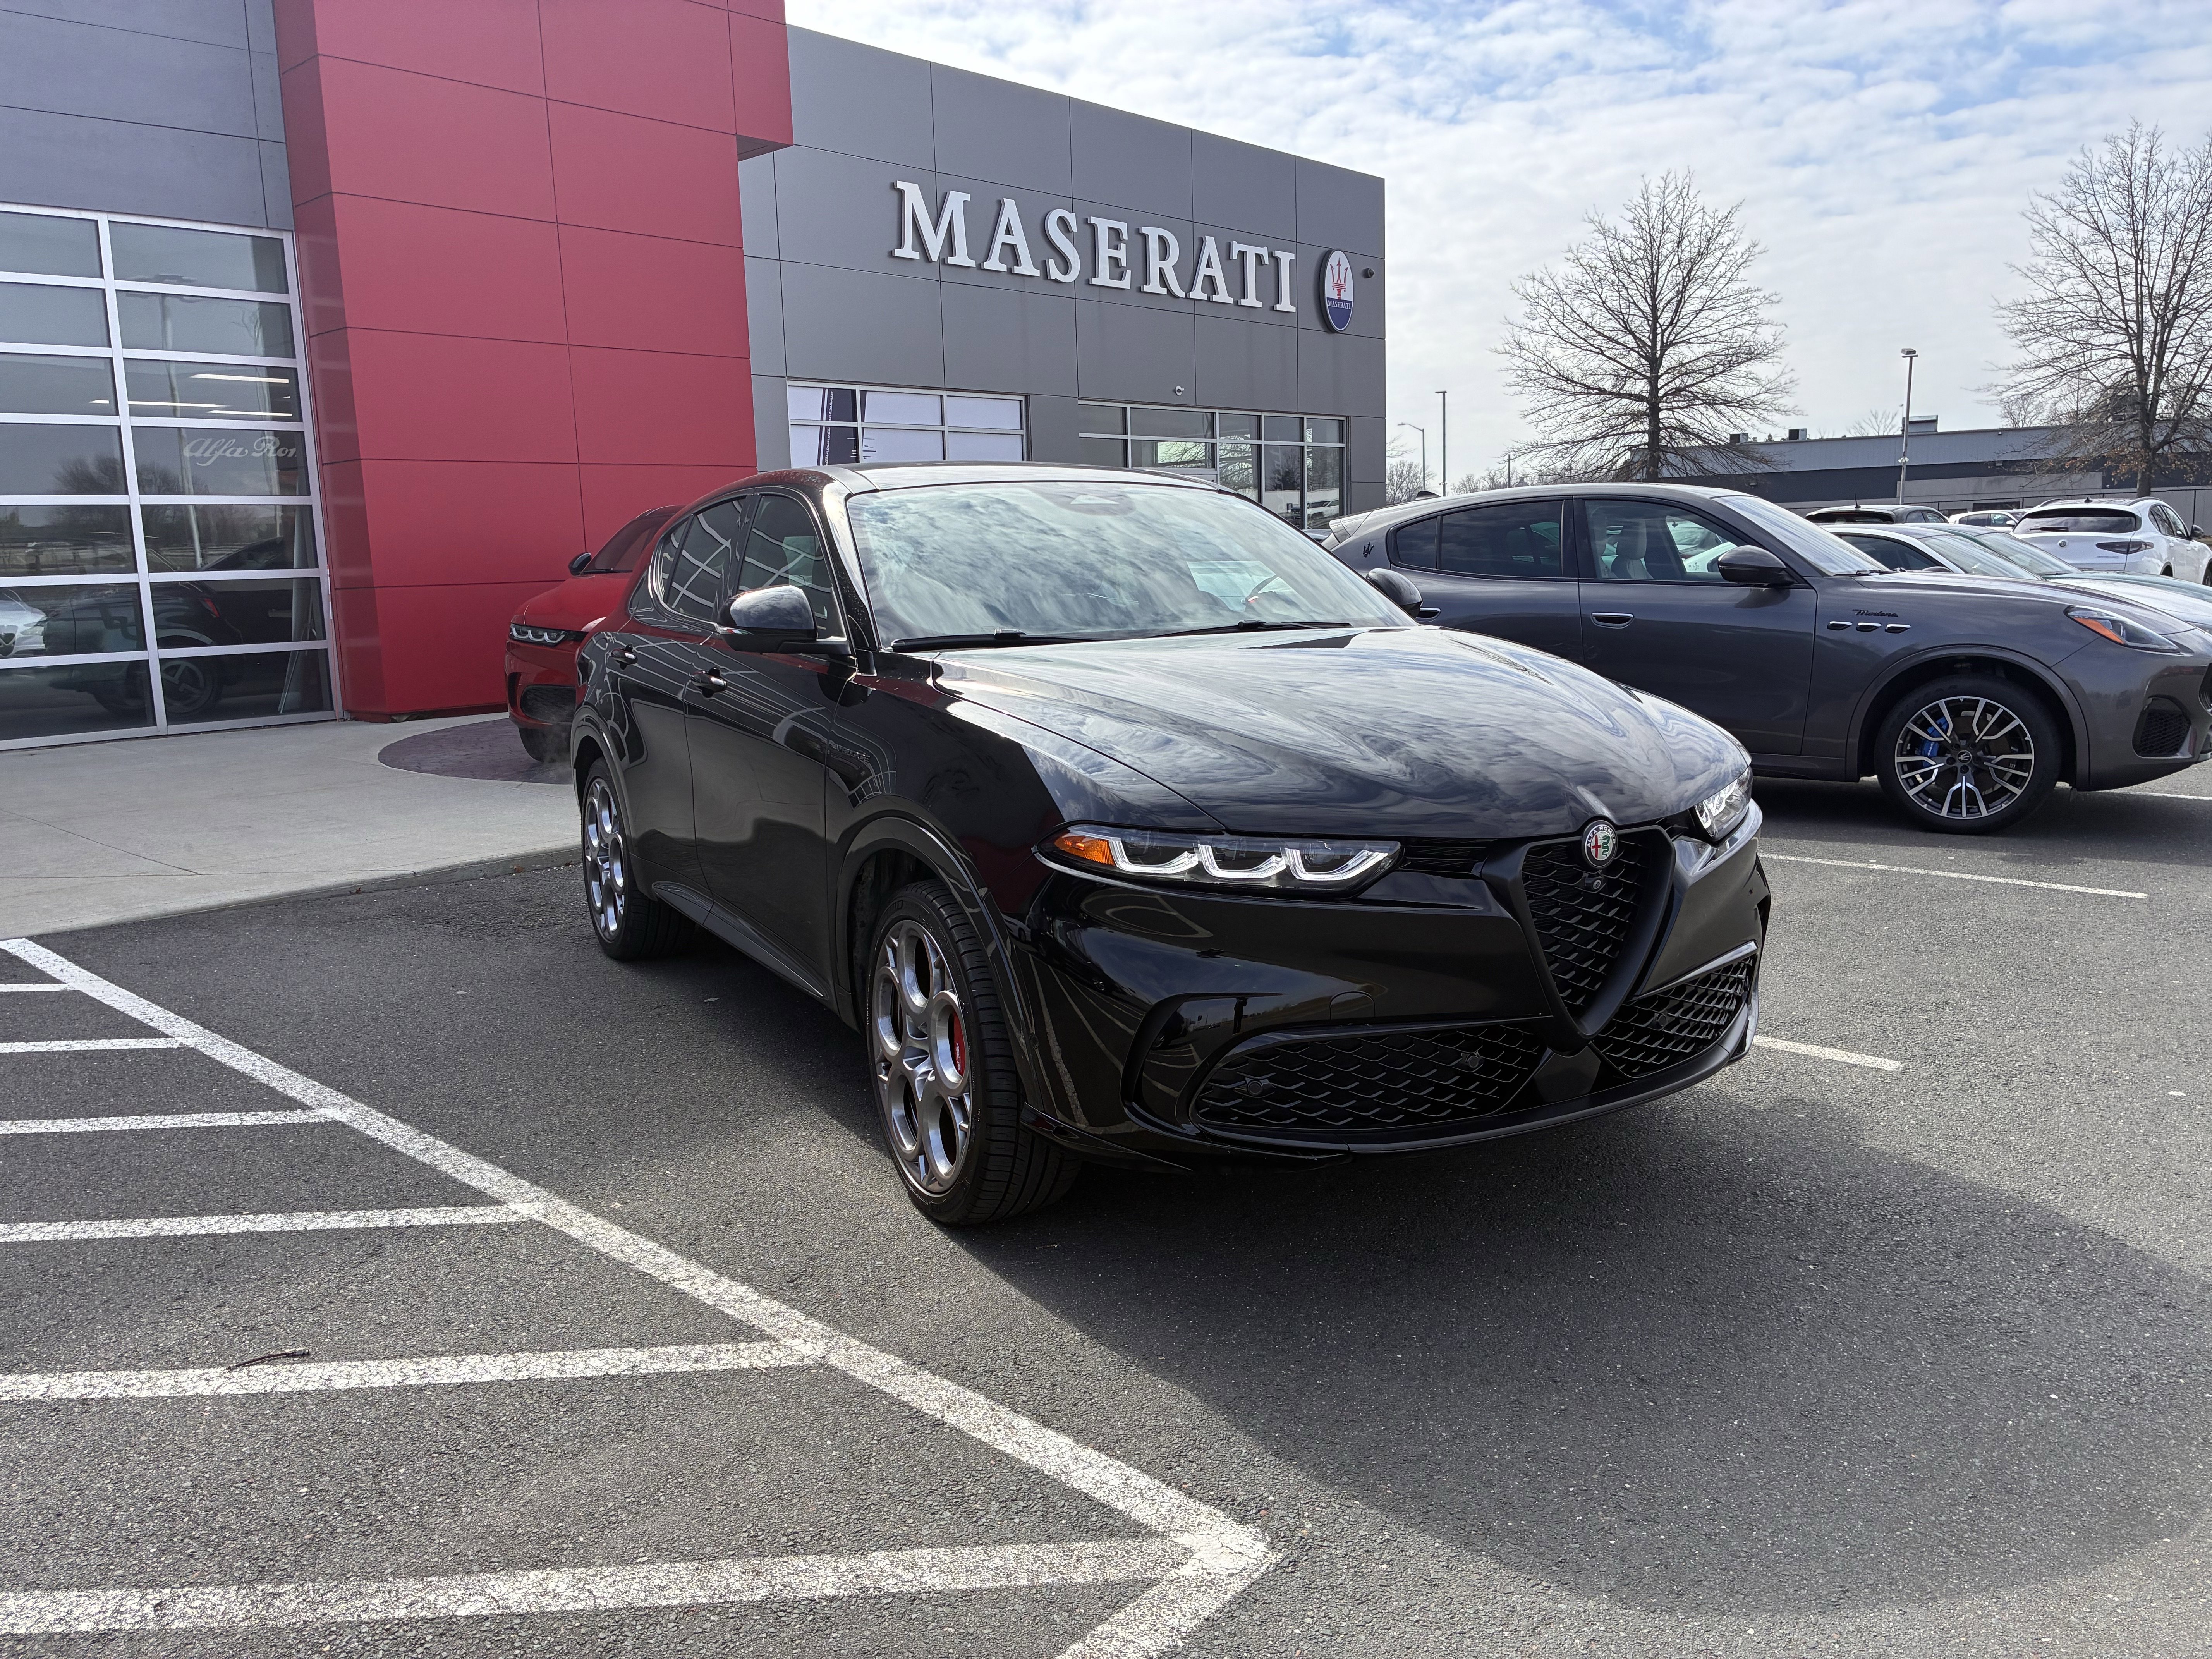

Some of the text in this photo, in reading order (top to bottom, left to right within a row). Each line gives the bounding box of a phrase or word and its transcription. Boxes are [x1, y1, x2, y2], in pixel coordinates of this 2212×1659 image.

[892, 180, 1296, 313] MASERATI
[1328, 300, 1351, 309] MASERATI
[183, 437, 248, 466] Alfa
[1587, 826, 1616, 848] ALFA ROMEO
